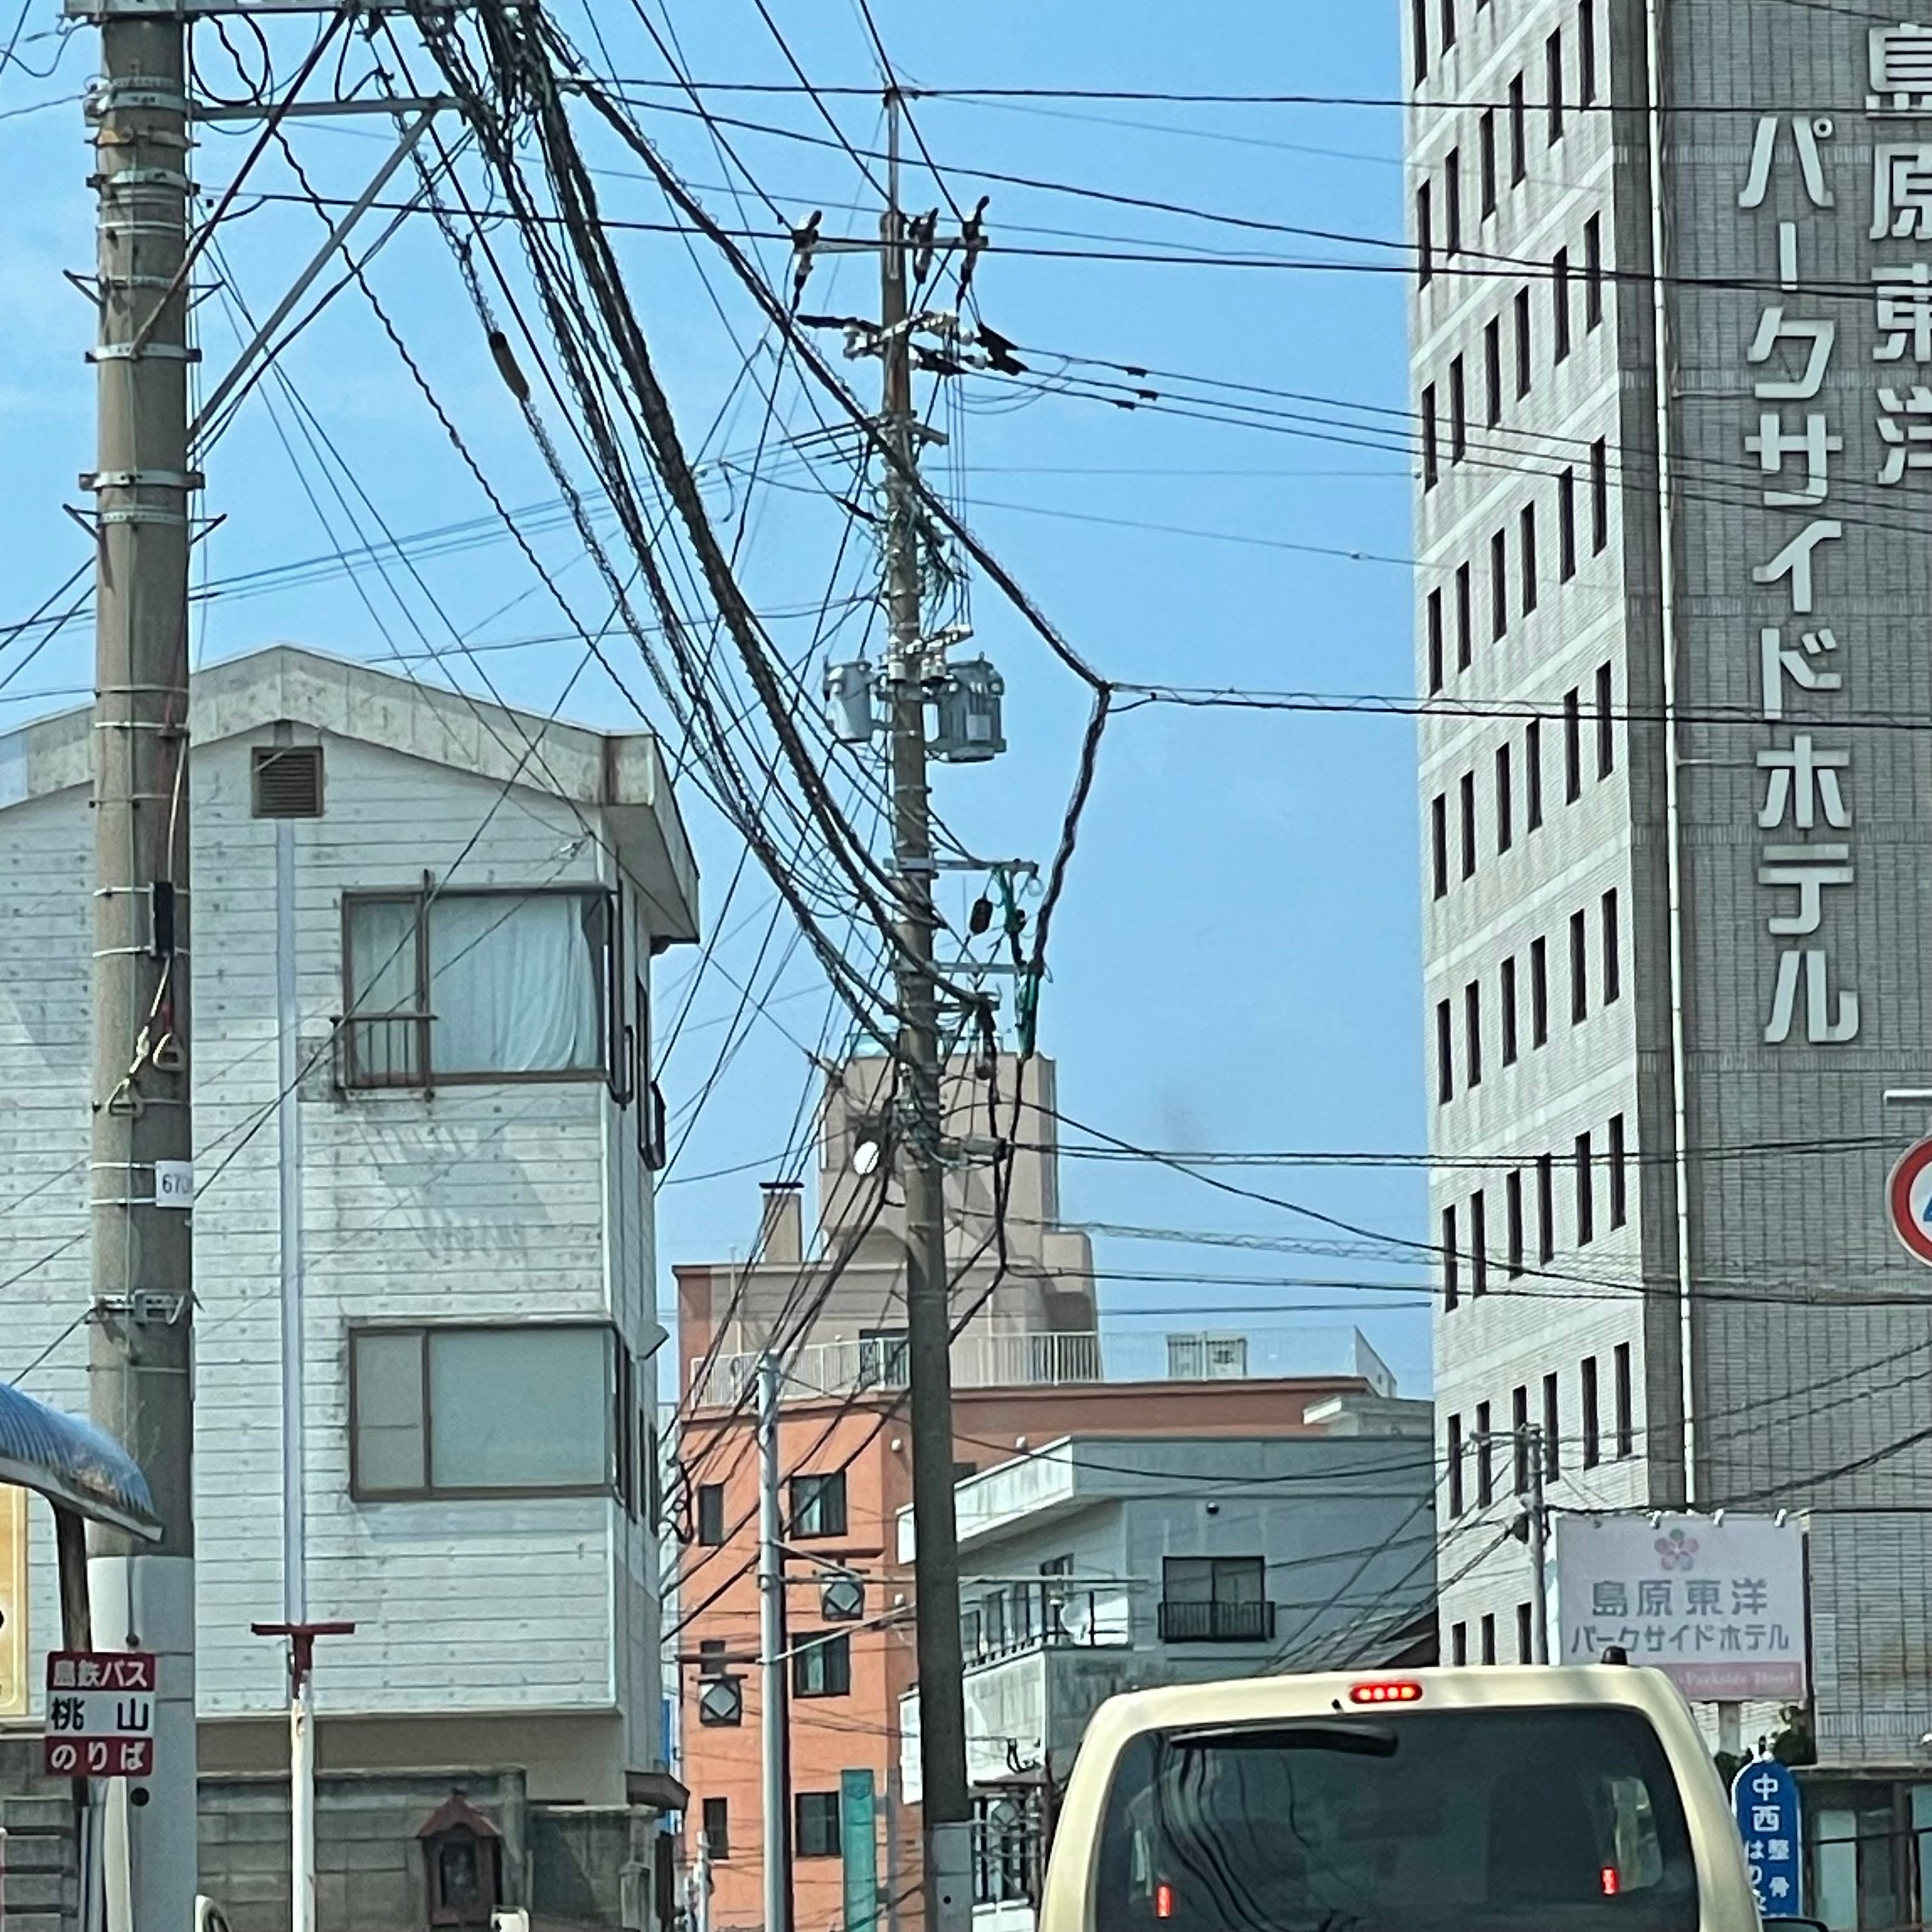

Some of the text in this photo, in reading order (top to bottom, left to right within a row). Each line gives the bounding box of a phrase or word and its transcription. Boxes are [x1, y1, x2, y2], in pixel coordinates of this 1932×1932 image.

[1738, 116, 1859, 1043] パークサイドホテル
[1592, 1577, 1768, 1617] 島原東洋
[1570, 1623, 1790, 1655] パークサイドホテル
[51, 1742, 146, 1770] のりば
